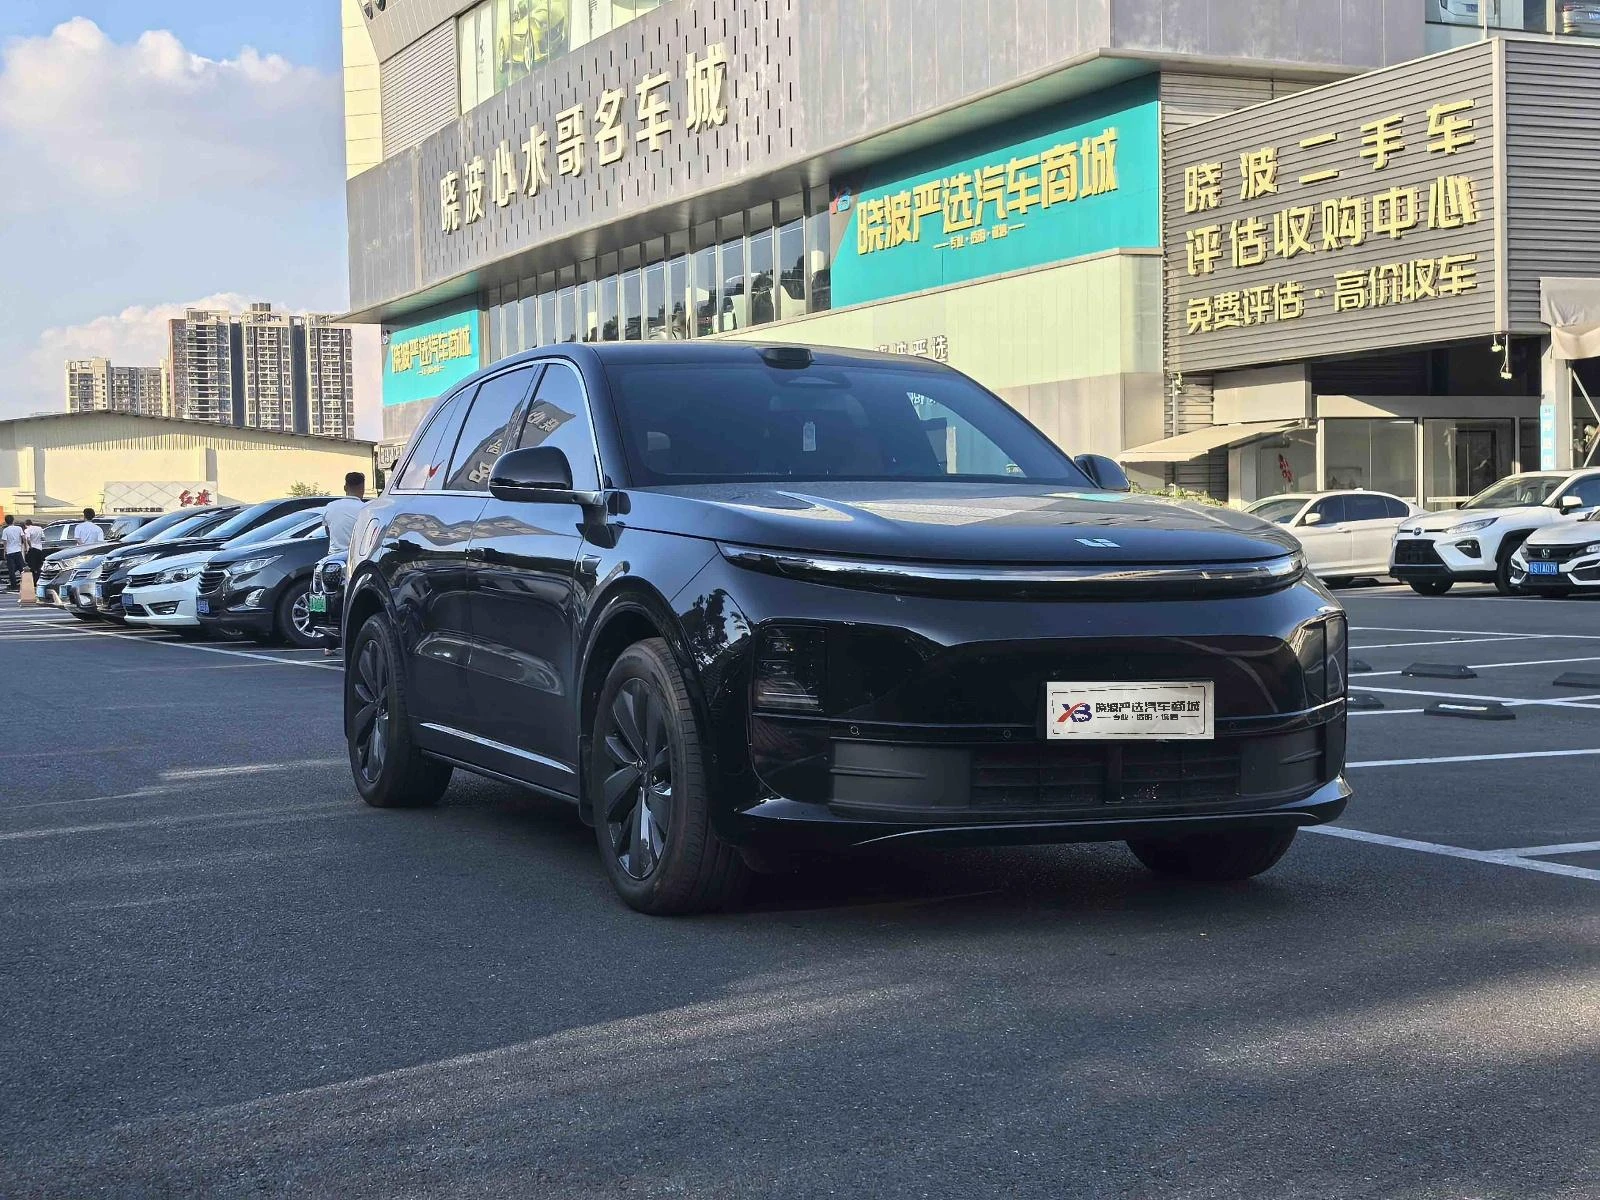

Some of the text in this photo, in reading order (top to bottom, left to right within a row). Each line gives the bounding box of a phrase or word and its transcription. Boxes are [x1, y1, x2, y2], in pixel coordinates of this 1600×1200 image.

[440, 43, 727, 234] 晓波心水哥名车城
[857, 127, 1118, 255] 晓波严选汽车商城
[1185, 99, 1478, 213] 晓波二手车
[1186, 176, 1480, 275] 评估收购中心
[1186, 254, 1478, 333] 免费评估·高价收车
[1095, 701, 1200, 713] 晓波严选汽车商城
